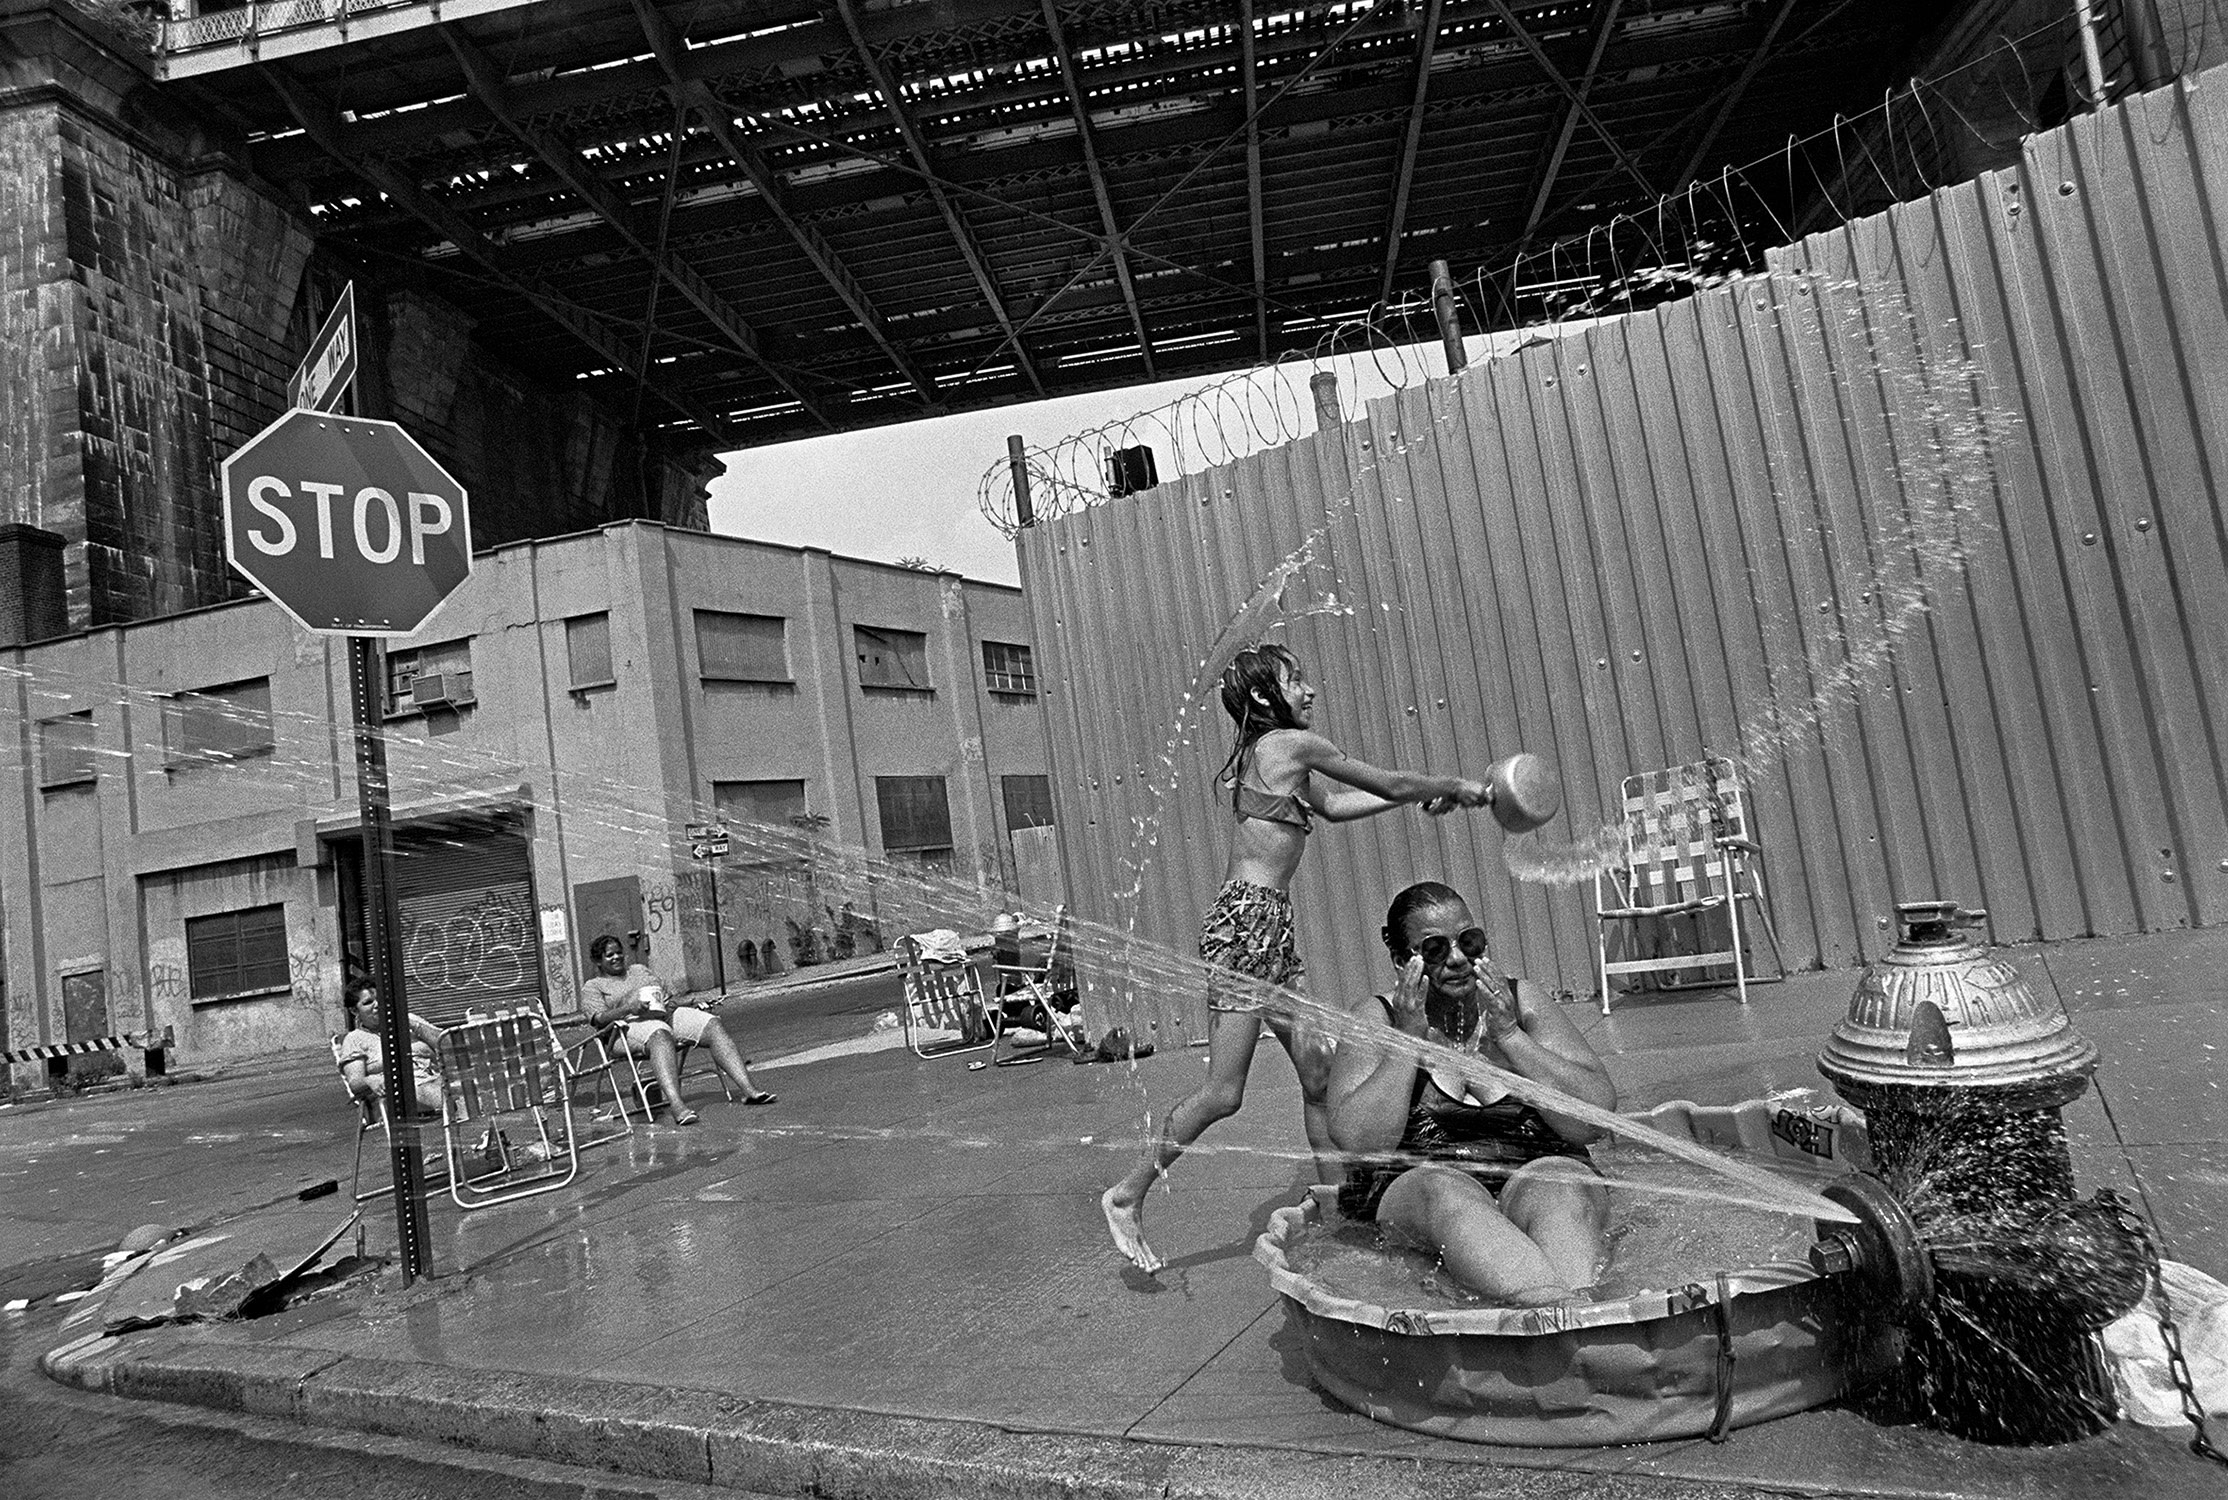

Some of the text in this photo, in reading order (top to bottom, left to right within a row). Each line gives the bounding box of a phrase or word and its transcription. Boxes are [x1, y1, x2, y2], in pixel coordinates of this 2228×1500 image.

[300, 320, 348, 411] ONE WAY
[247, 475, 453, 565] STOP
